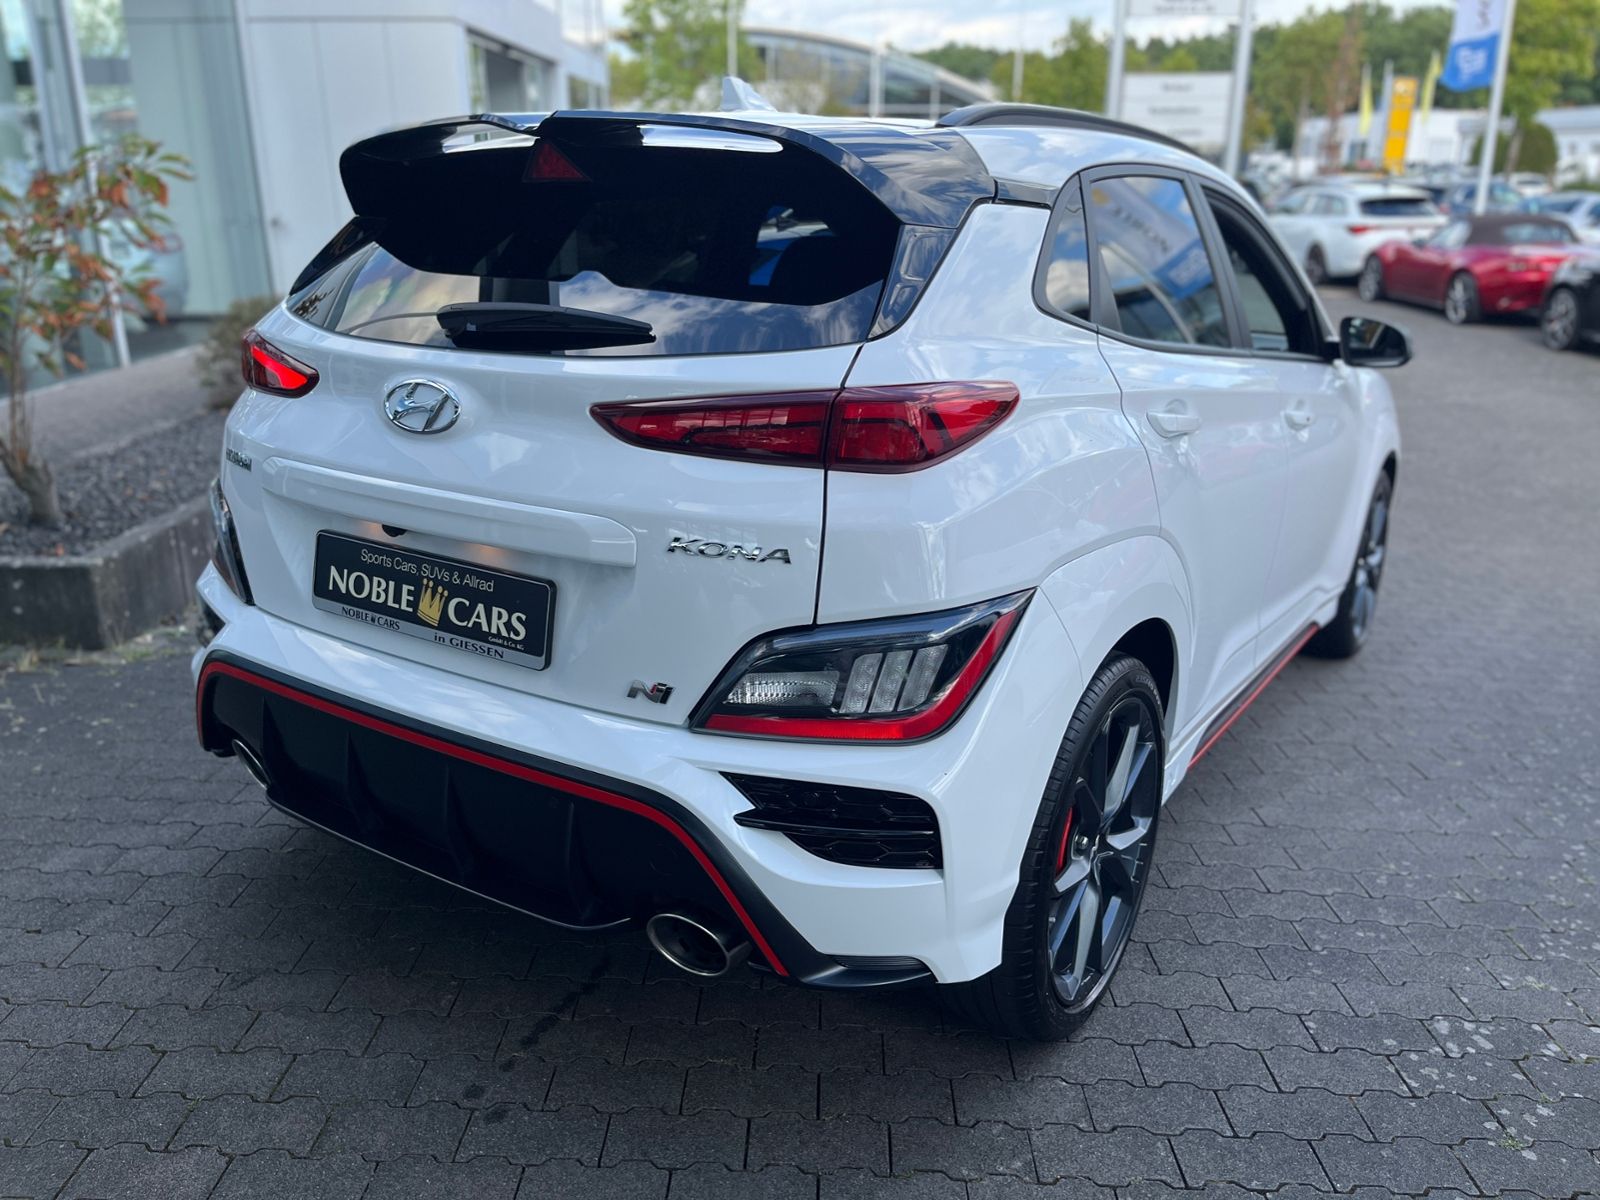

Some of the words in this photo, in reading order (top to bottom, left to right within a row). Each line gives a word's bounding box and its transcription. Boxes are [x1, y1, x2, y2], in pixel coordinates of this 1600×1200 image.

[667, 537, 791, 564] KONA
[361, 548, 392, 567] Sports
[394, 557, 419, 576] Cars,
[421, 563, 450, 582] SUVs
[452, 571, 461, 584] &
[462, 574, 495, 592] Allrad
[329, 565, 415, 612] NOBLE
[447, 597, 527, 641] CARS
[341, 606, 369, 622] NOBLE
[377, 616, 400, 631] CARS
[434, 632, 445, 643] in
[450, 637, 504, 659] GIESSEN
